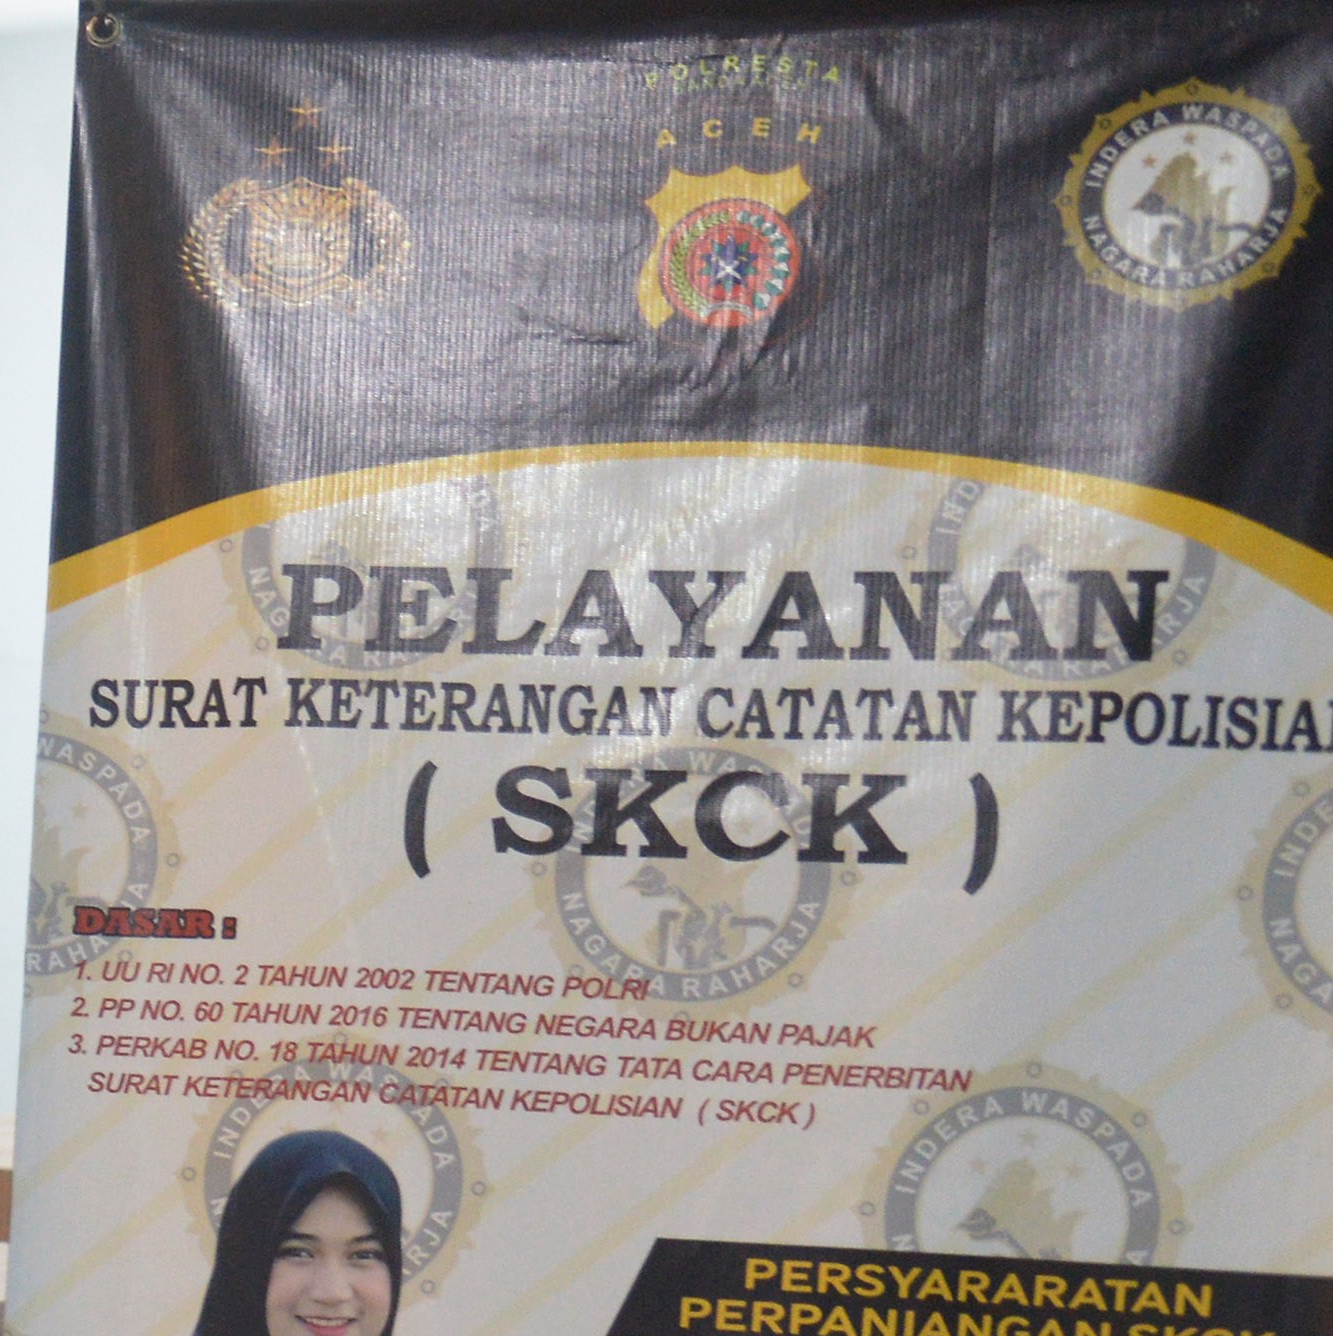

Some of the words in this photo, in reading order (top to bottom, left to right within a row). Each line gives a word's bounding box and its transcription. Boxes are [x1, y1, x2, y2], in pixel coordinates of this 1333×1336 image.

[645, 54, 840, 89] POLRESTA
[657, 117, 821, 149] ACEH
[1086, 109, 1170, 188] INDERA
[1182, 104, 1290, 179] WASPADA
[1083, 216, 1167, 287] NAGARA
[1176, 207, 1287, 288] RAHARJA
[278, 563, 1169, 662] PELAYANAN
[89, 676, 267, 729] SURAT
[284, 677, 676, 736] KETERANGAN
[696, 686, 977, 742] CATATAN
[998, 689, 1333, 753] KEPOLISIA
[491, 765, 908, 865] SKCK
[73, 906, 215, 939] DASAR
[73, 959, 91, 980] 1.
[102, 959, 141, 983] UU
[147, 962, 174, 984] RI
[180, 963, 223, 986] NO.
[234, 964, 249, 985] 2
[259, 965, 348, 988] TAHUN
[355, 967, 415, 991] 2002
[426, 969, 554, 997] TENTANG
[562, 974, 650, 1000] POLRI
[71, 996, 89, 1018] 2.
[99, 998, 135, 1019] PP
[140, 999, 184, 1022] NO.
[195, 1001, 224, 1023] 60
[233, 1001, 322, 1025] TAHUN
[329, 1004, 388, 1028] 2016
[399, 1006, 527, 1034] TENTANG
[535, 1013, 656, 1040] NEGARA
[665, 1018, 771, 1044] BUKAN
[778, 1023, 876, 1048] PAJAK
[68, 1033, 86, 1055] 3.
[96, 1035, 207, 1060] PERKAB
[215, 1039, 258, 1062] NO.
[270, 1041, 300, 1062] 18
[308, 1042, 399, 1067] TAHUN
[406, 1046, 466, 1070] 2014
[477, 1049, 607, 1077] TENTANG
[618, 1055, 682, 1080] TATA
[693, 1059, 773, 1084] CARA
[783, 1063, 972, 1092] PENERBITAN
[88, 1071, 180, 1097] SURAT
[183, 1076, 370, 1104] KETERANGAN
[379, 1082, 506, 1112] CATATAN
[510, 1090, 684, 1120] KEPOLISIAN
[716, 1099, 800, 1125] SKCK
[895, 1096, 1005, 1195] INDERA
[1020, 1091, 1153, 1207] WASPADA
[744, 1257, 1213, 1318] PERSYARARATAN
